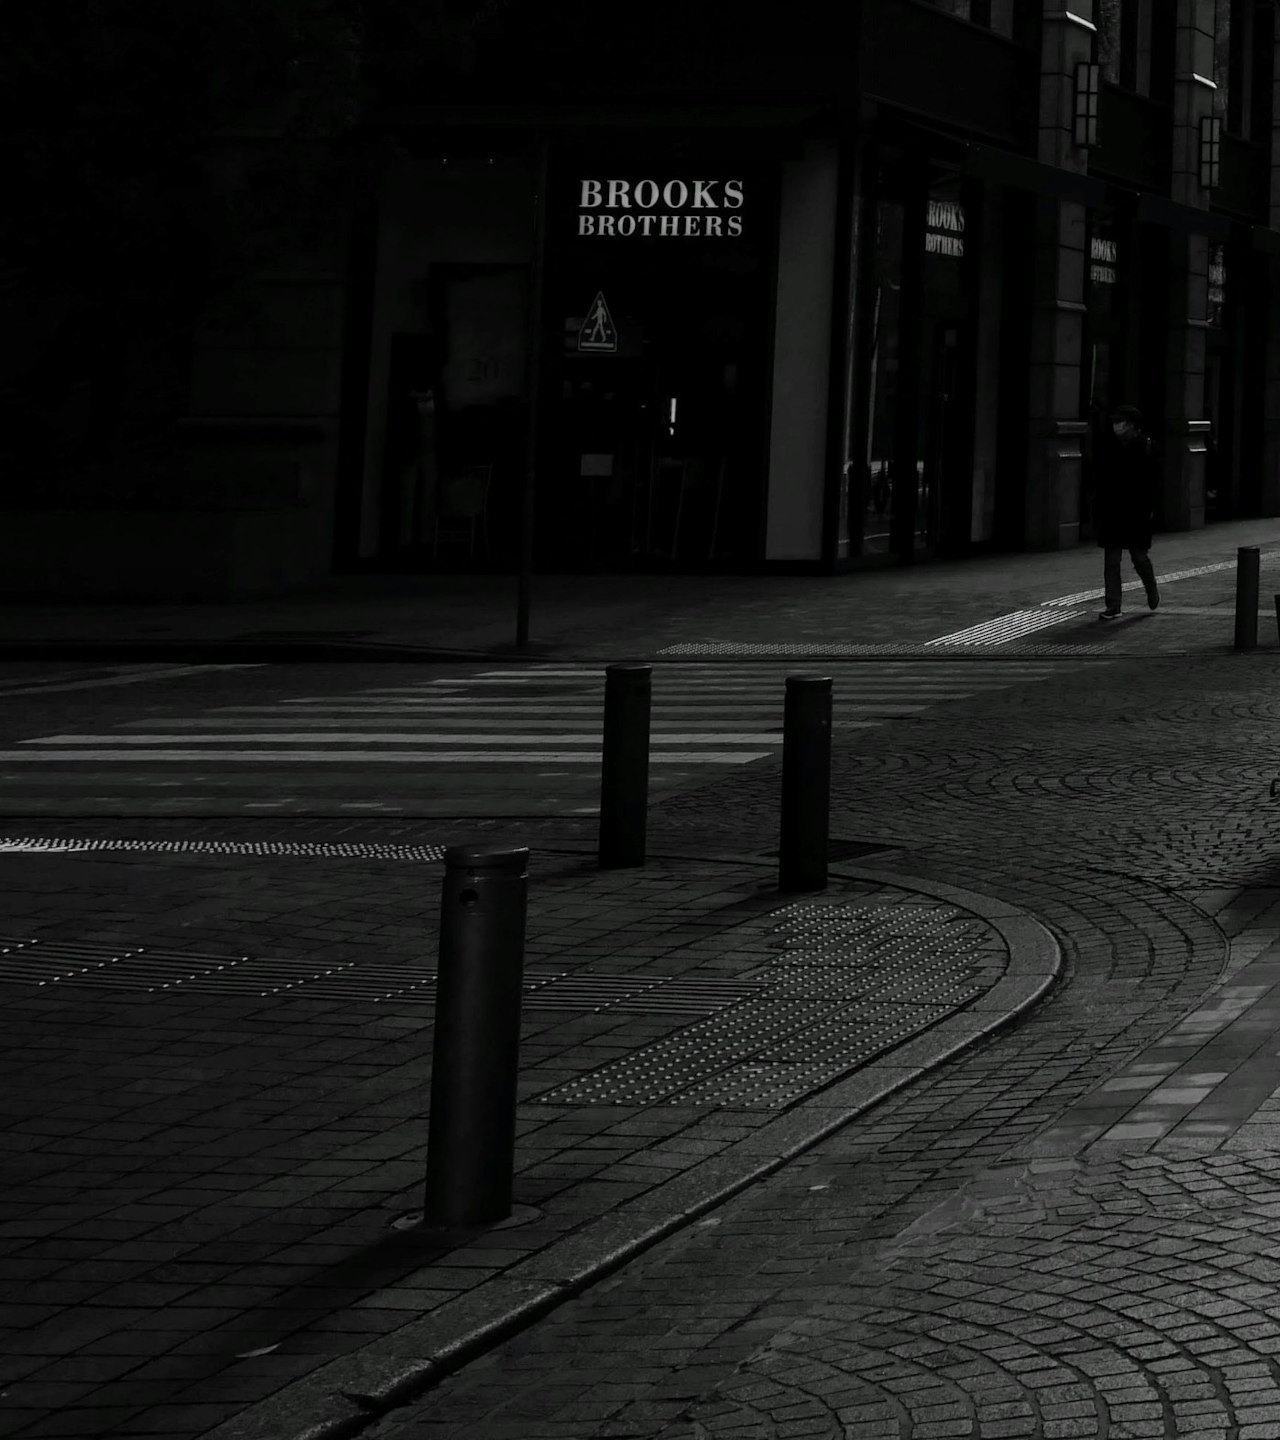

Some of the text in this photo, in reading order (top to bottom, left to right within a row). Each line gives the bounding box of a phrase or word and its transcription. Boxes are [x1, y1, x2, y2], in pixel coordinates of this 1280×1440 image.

[578, 179, 744, 209] BROOKS
[577, 215, 743, 237] BROTHERS
[926, 200, 966, 232] ROOKS
